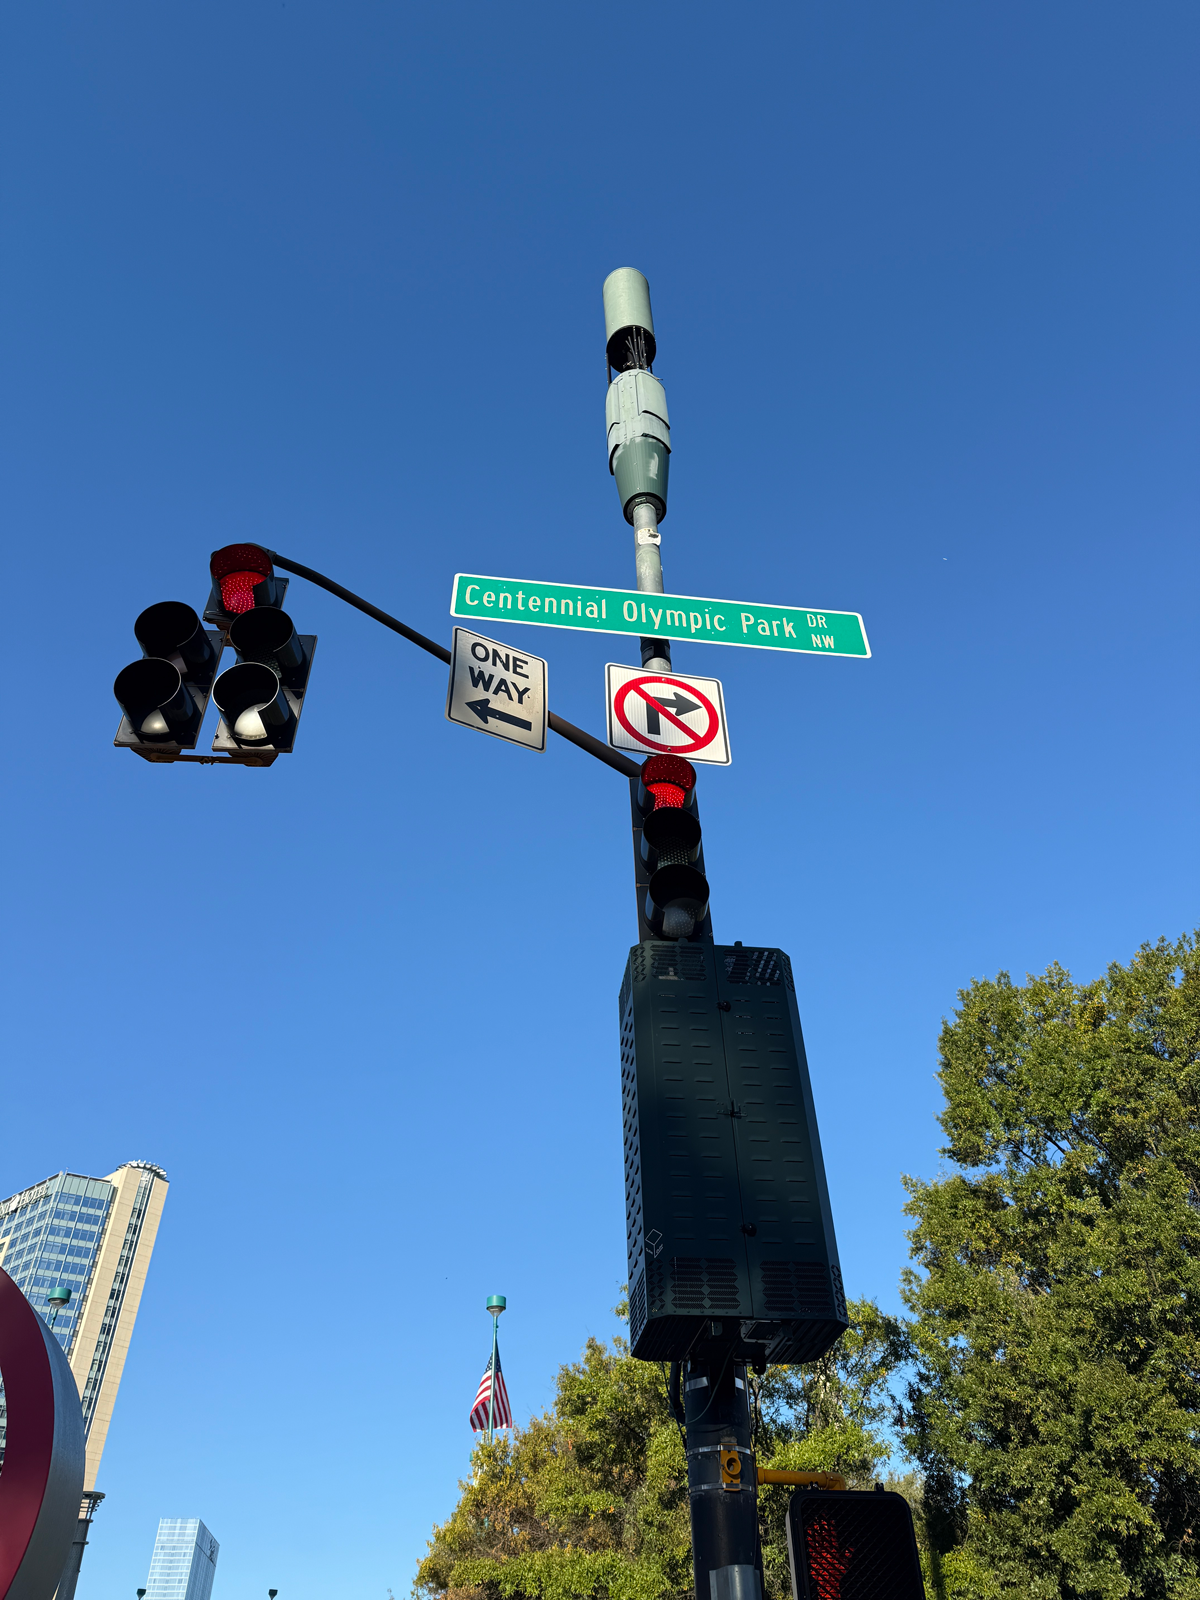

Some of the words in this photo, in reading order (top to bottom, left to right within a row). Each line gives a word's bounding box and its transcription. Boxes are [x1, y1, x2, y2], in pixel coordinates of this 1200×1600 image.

[465, 584, 606, 619] Centennial
[623, 600, 726, 633] Olympic
[740, 612, 797, 638] Park
[806, 613, 828, 629] DR
[811, 633, 835, 649] NW
[471, 642, 530, 679] ONE
[468, 665, 531, 705] WAY
